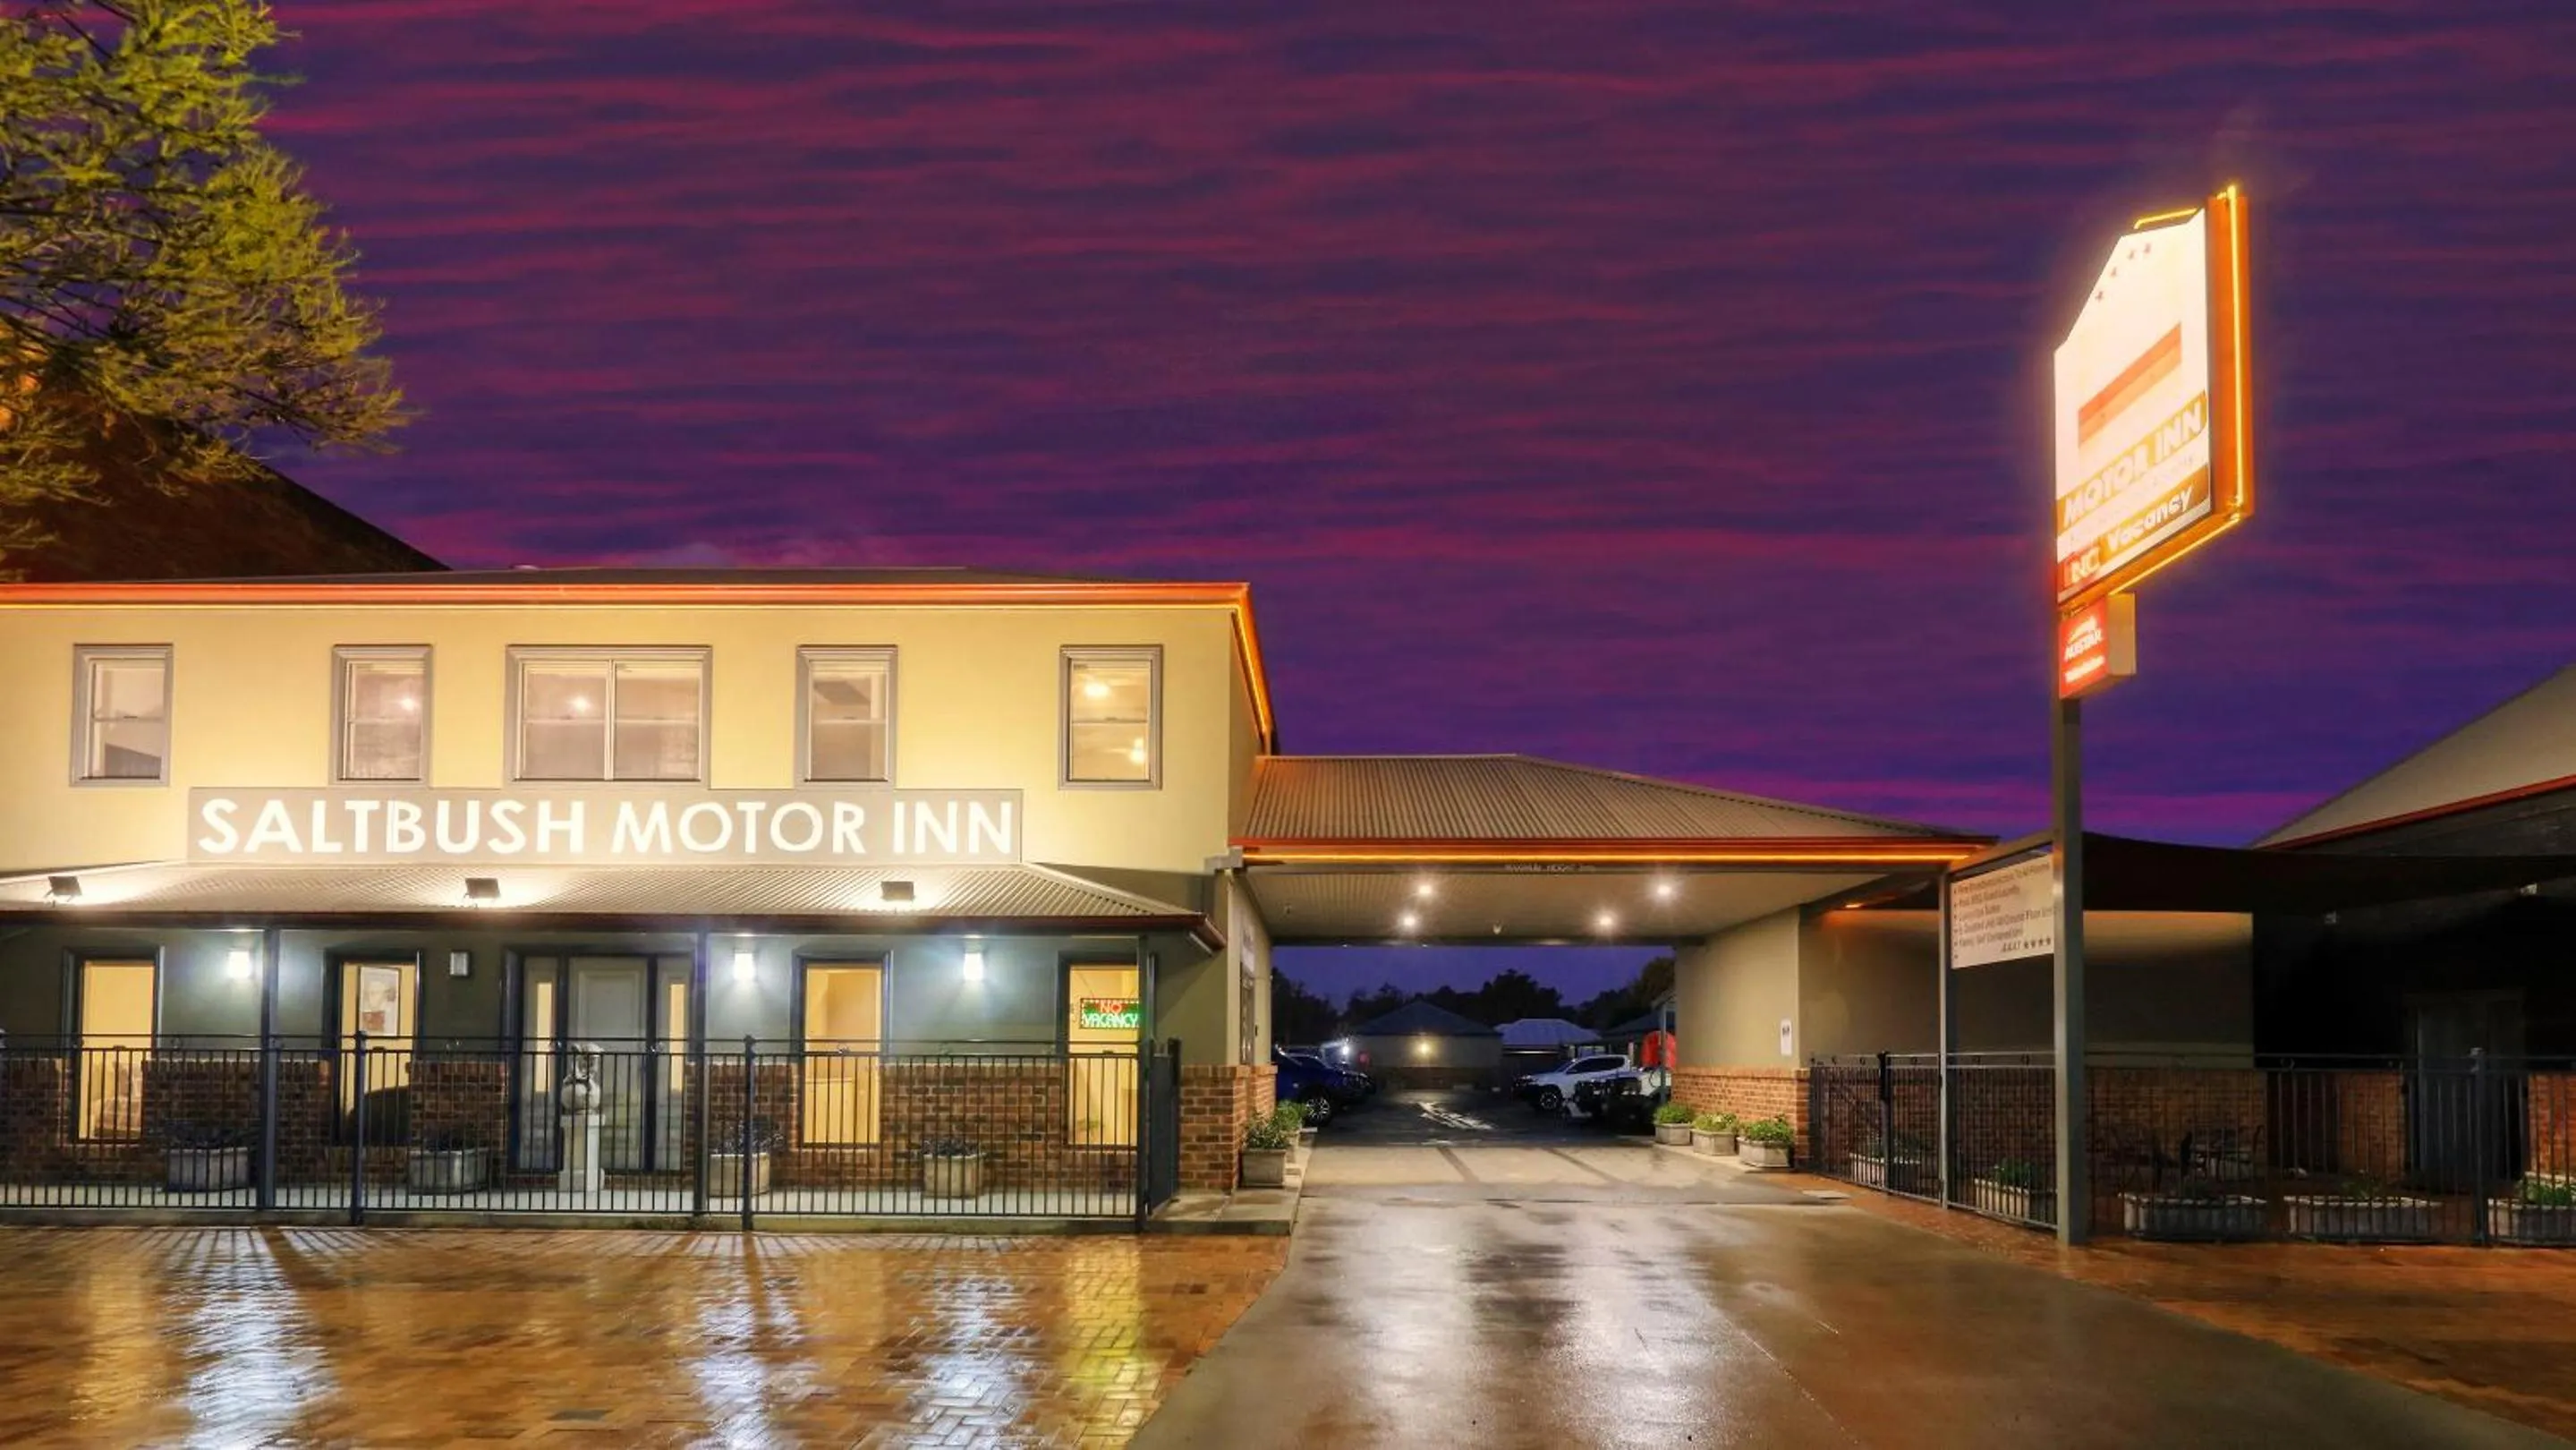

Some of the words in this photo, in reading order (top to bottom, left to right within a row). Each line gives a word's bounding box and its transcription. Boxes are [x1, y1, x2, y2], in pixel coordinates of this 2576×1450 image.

[2155, 402, 2202, 464] INN
[198, 798, 584, 854] SALTBUSH
[611, 801, 867, 854] MOTOR
[893, 801, 1012, 855] INN
[1083, 1013, 1138, 1028] VACANCY
[1100, 1000, 1122, 1013] NO
